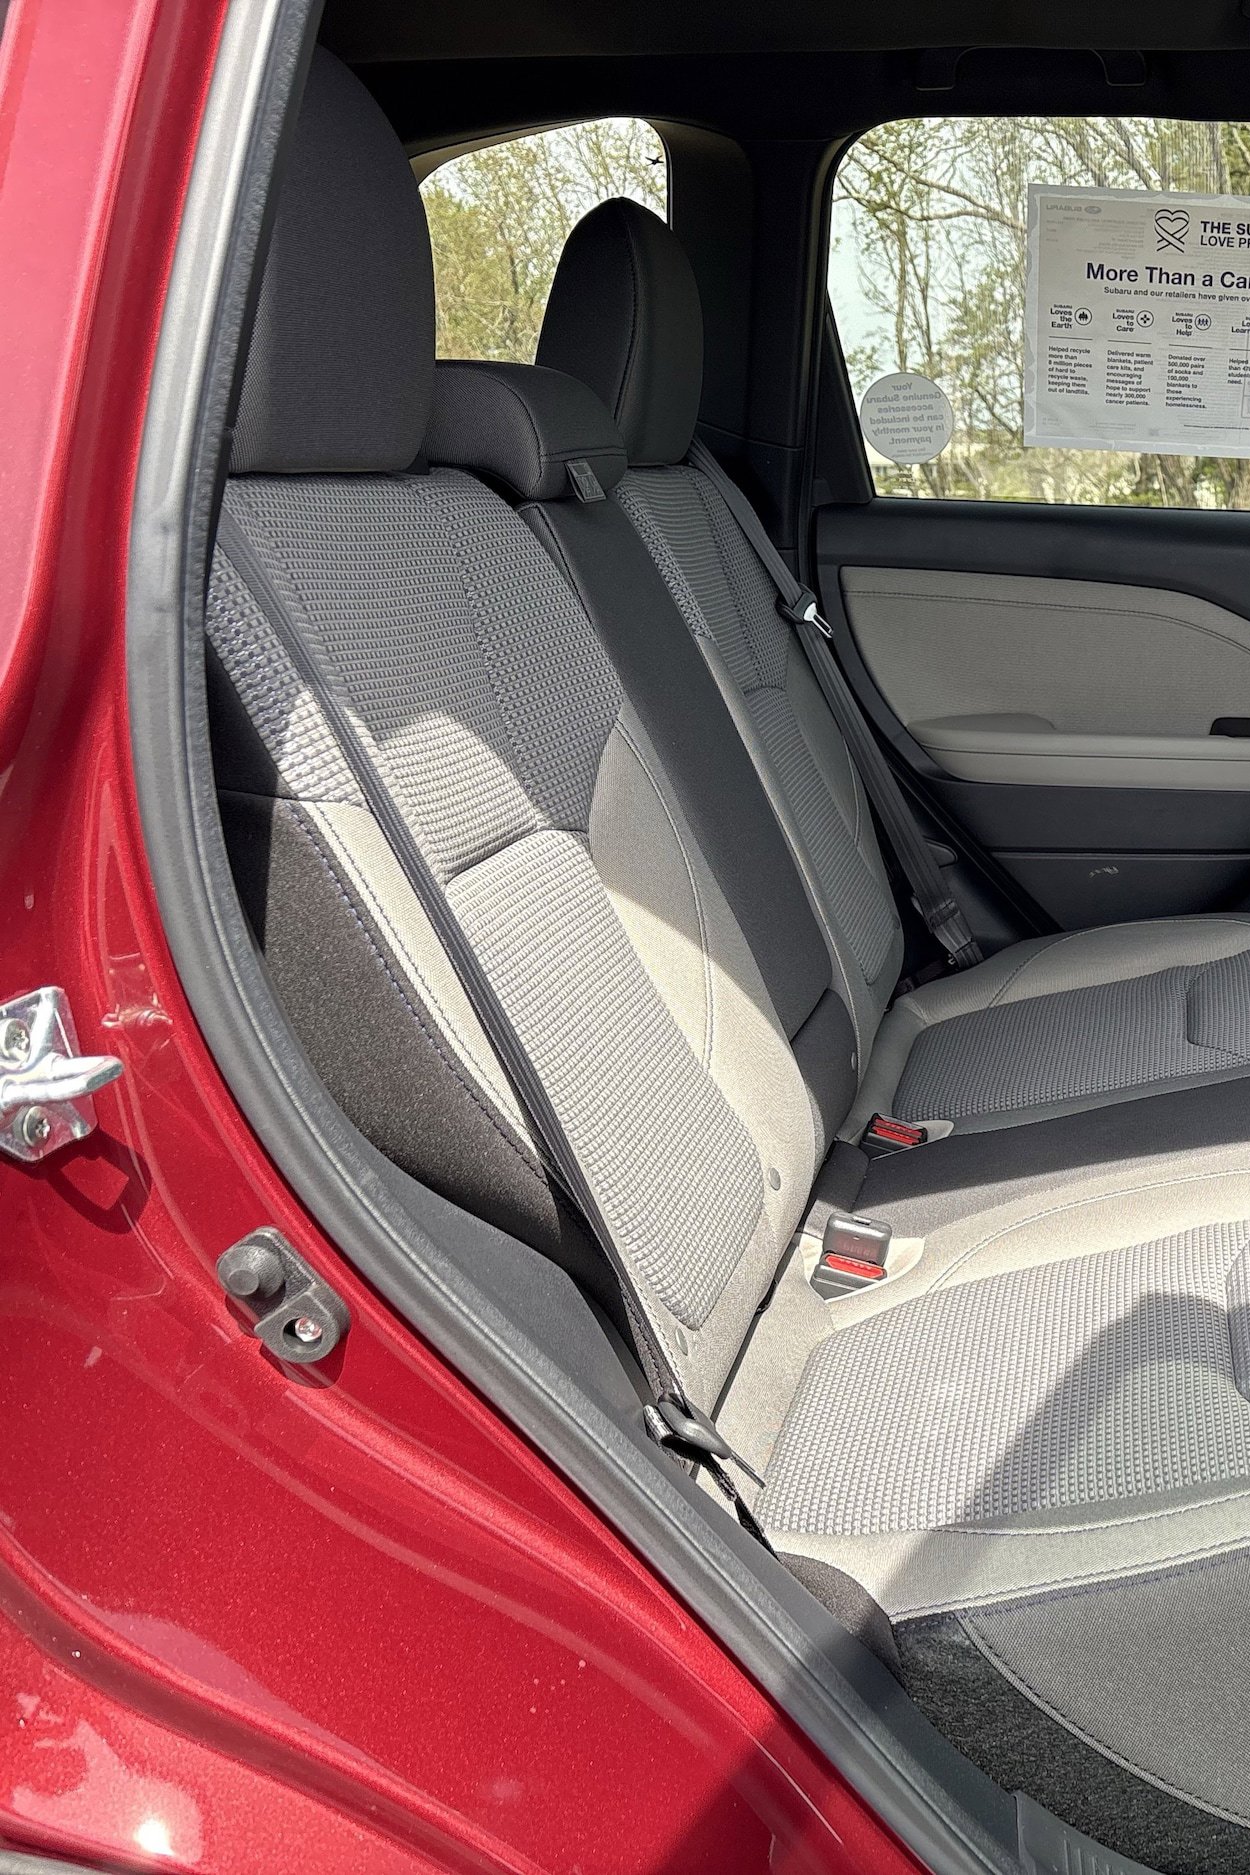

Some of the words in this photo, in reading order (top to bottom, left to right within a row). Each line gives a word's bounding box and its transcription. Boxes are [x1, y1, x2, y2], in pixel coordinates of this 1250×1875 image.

[1200, 221, 1231, 235] THE
[1200, 235, 1234, 248] LOVE
[1086, 262, 1139, 282] More
[1145, 266, 1195, 286] Than
[1202, 274, 1213, 287] a
[1104, 286, 1132, 295] Subaru
[1165, 290, 1196, 299] retailers
[1198, 292, 1216, 301] have
[1218, 294, 1239, 303] given
[1050, 308, 1072, 316] Loves
[1107, 371, 1141, 379] encouraging
[1048, 380, 1070, 388] keeping
